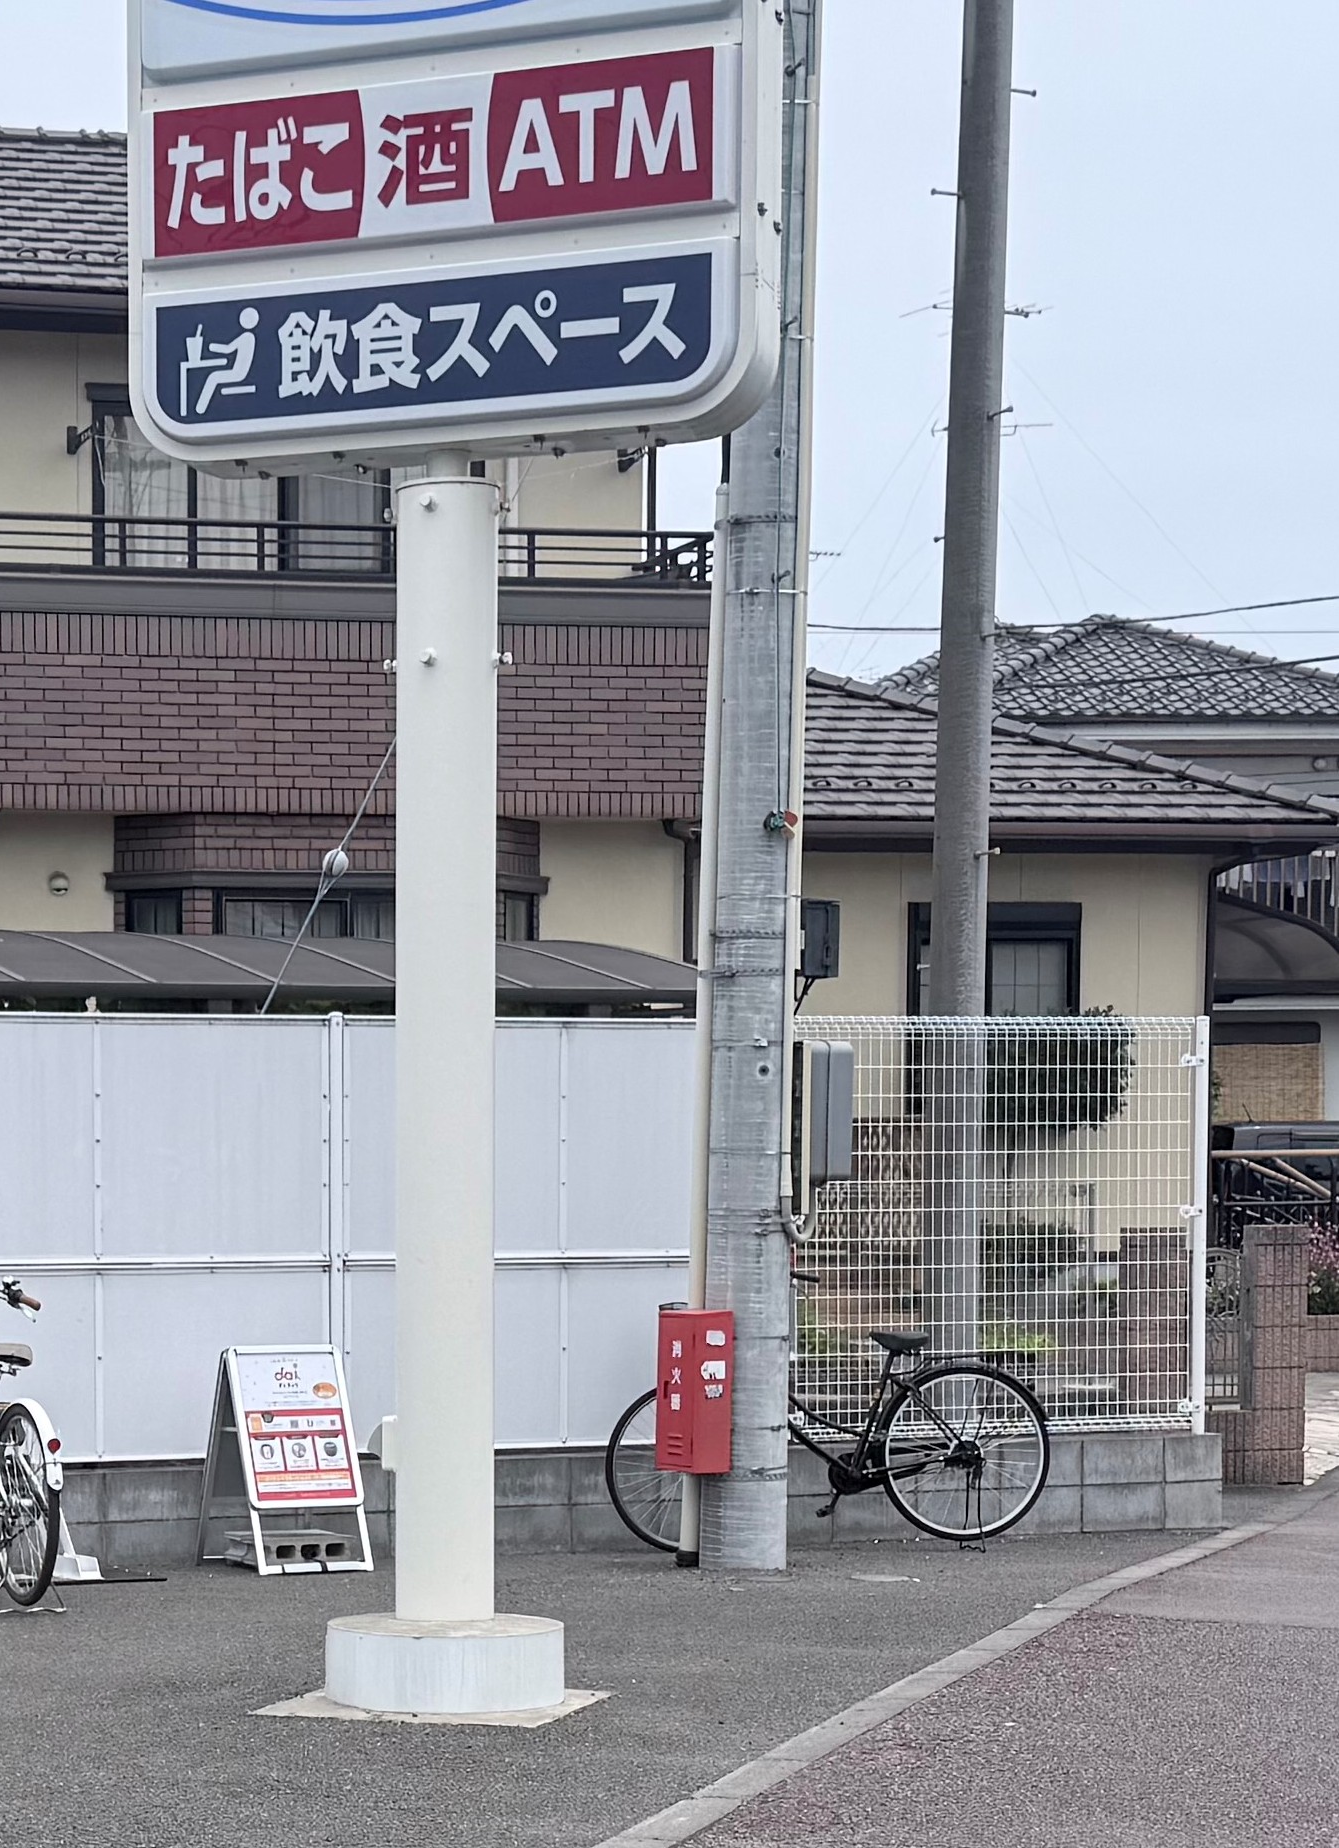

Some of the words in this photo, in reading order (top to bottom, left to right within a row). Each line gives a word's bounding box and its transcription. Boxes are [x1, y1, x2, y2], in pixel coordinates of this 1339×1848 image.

[167, 116, 353, 230] たばこ
[377, 107, 474, 209] 酒
[498, 80, 698, 192] ATM
[277, 282, 686, 399] 飲食スペース
